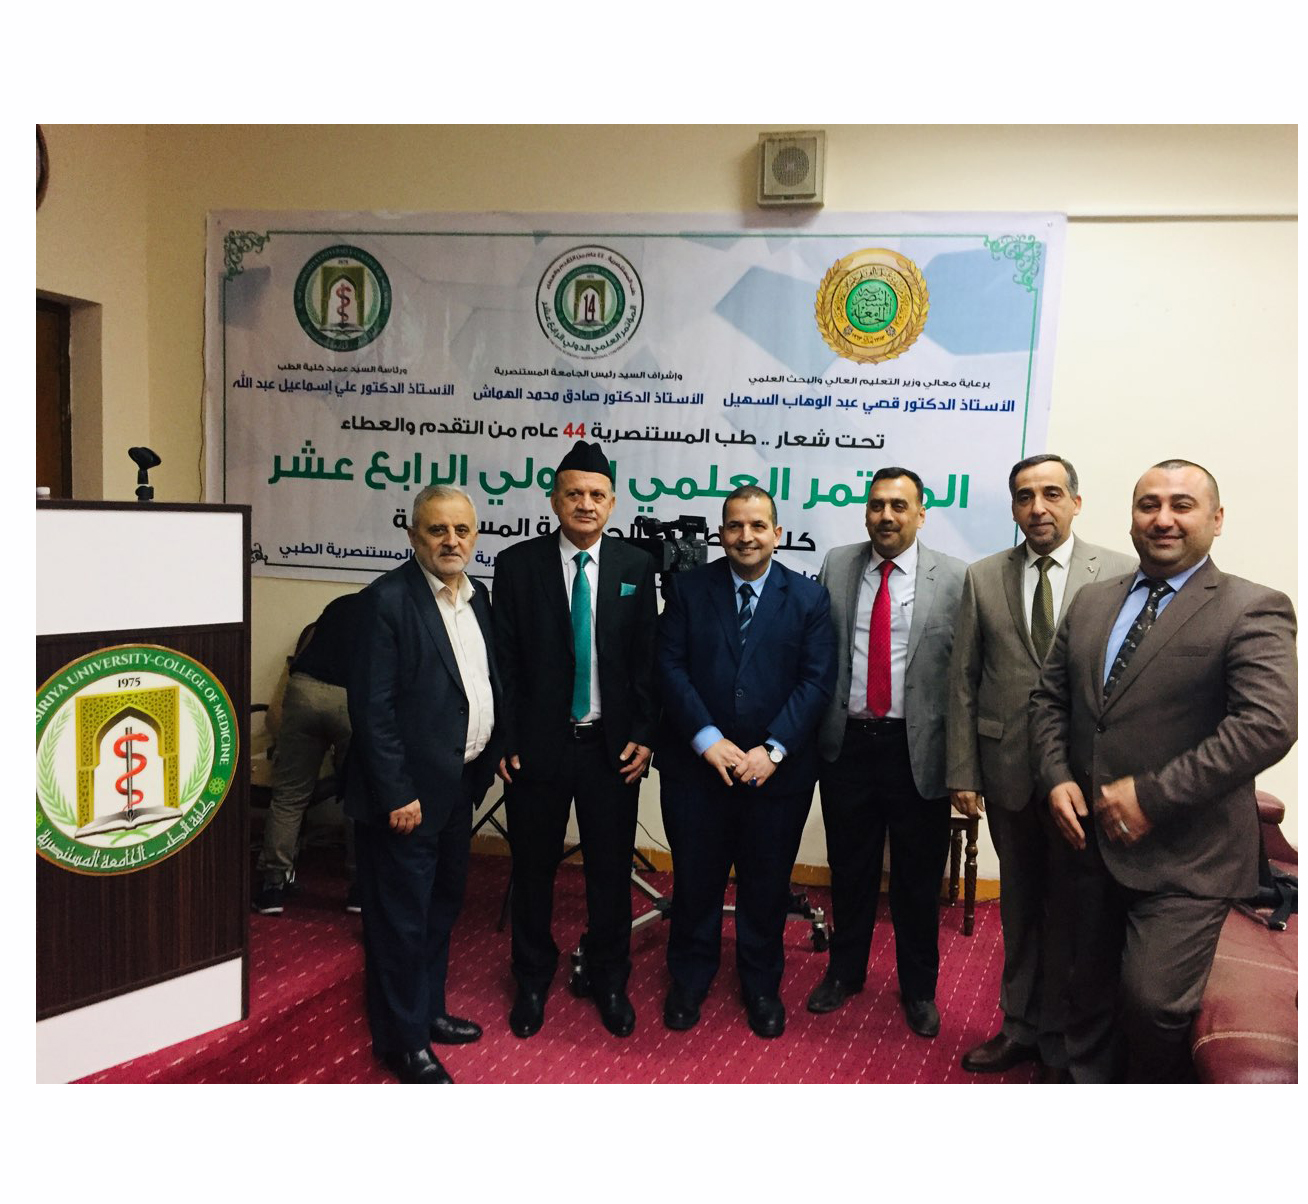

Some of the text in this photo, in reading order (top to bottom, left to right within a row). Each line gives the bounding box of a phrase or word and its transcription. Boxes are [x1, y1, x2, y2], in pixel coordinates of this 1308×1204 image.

[541, 301, 552, 322] عشر
[583, 293, 596, 323] 14
[547, 322, 566, 342] الرابع
[562, 339, 591, 352] الدولي
[591, 332, 622, 355] العلمي
[277, 362, 408, 376] ورئاسة السيد عميد كلية الطب
[493, 366, 683, 382] وإشراف السيد رئيس الجامعة المستنصرية
[232, 370, 455, 399] الأستاذ الدكتور علي إسماعيل عبد الله
[748, 374, 991, 390] برعاية معالي وزير التعليم العالي والبحث العلمي
[472, 384, 705, 406] الأستاذ الدكتور صادق محمد الهماش
[722, 392, 1016, 415] الأستاذ الدكتور قصي عبد الوهاب السهيل
[340, 415, 416, 436] والعطاء
[419, 417, 484, 436] التقدم
[487, 421, 517, 439] من
[521, 422, 559, 440] عام
[562, 422, 587, 440] 44
[590, 422, 710, 445] المستنصرية
[715, 429, 757, 448] طب
[775, 428, 831, 449] شعار
[834, 433, 886, 450] تحت
[267, 440, 354, 485] عشر
[364, 450, 469, 492] الرابع
[628, 464, 791, 513] العلمي
[278, 542, 323, 559] الطبي
[117, 677, 142, 688] 1975
[204, 687, 218, 703] OF
[212, 702, 231, 765] MEDICINE
[191, 800, 216, 827] كلية
[36, 829, 100, 868] المستنصرية
[100, 845, 148, 869] الجامعة
